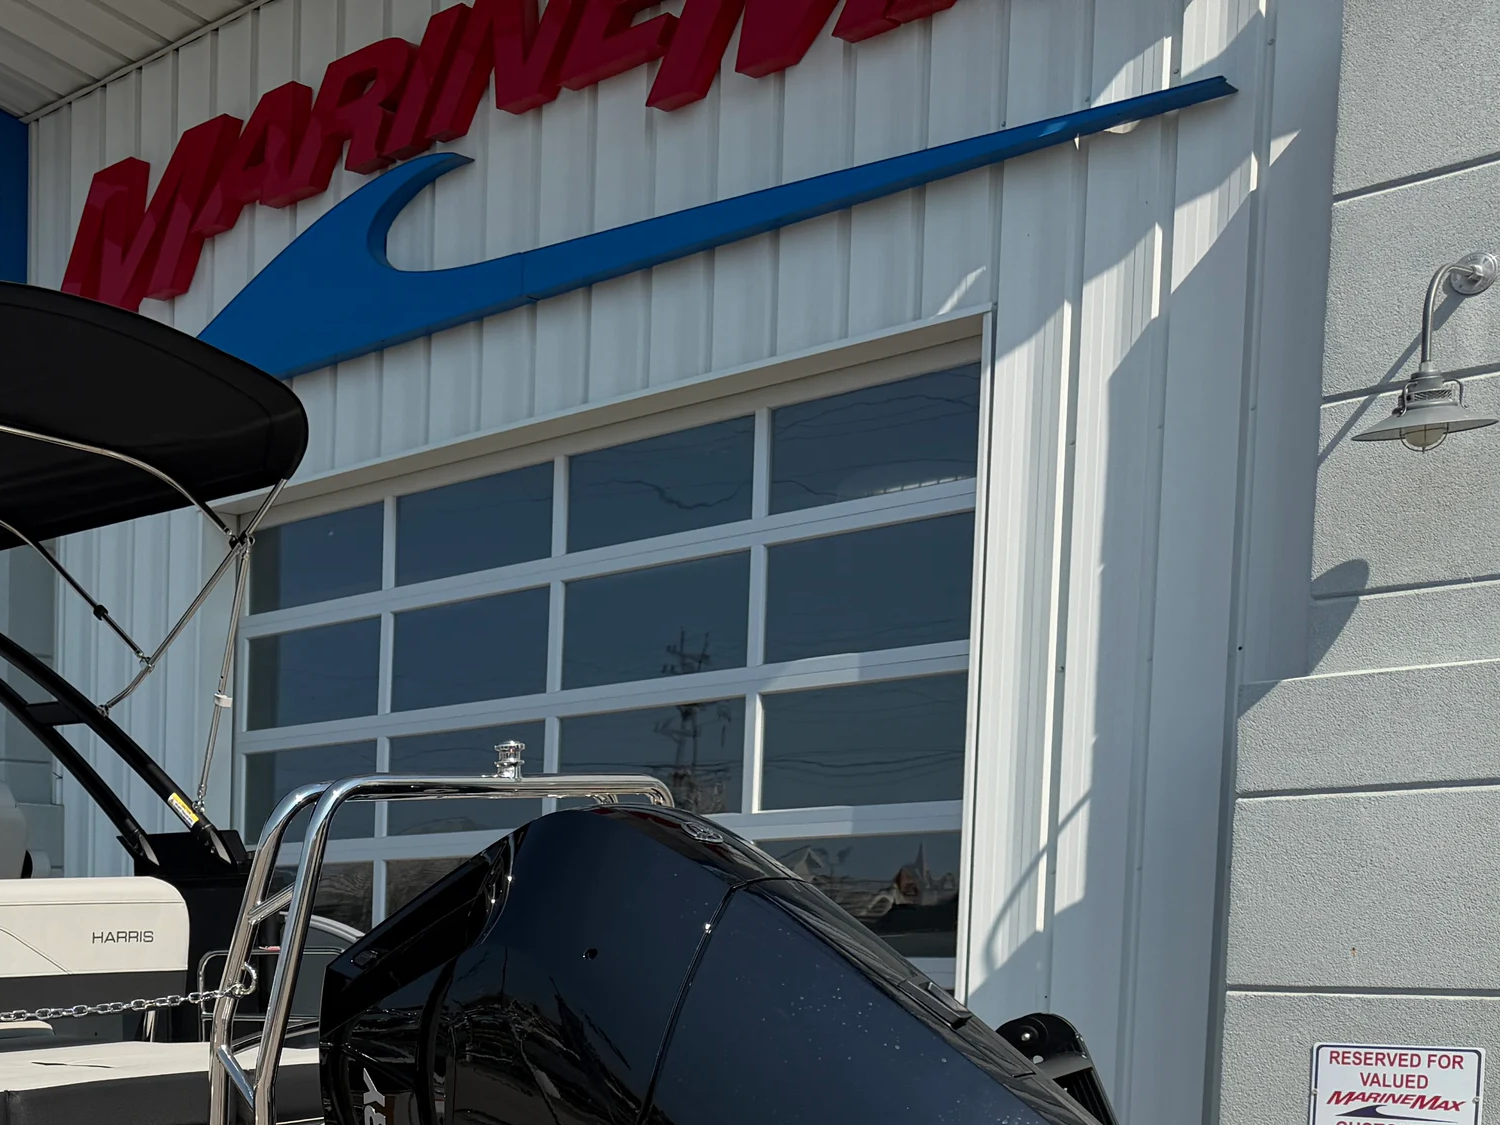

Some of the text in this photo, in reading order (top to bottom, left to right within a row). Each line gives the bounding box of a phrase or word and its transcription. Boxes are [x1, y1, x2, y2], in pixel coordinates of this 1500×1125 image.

[92, 931, 154, 944] HARRIS
[1329, 1050, 1464, 1070] RESERVED FOR
[1359, 1072, 1429, 1089] VALUED
